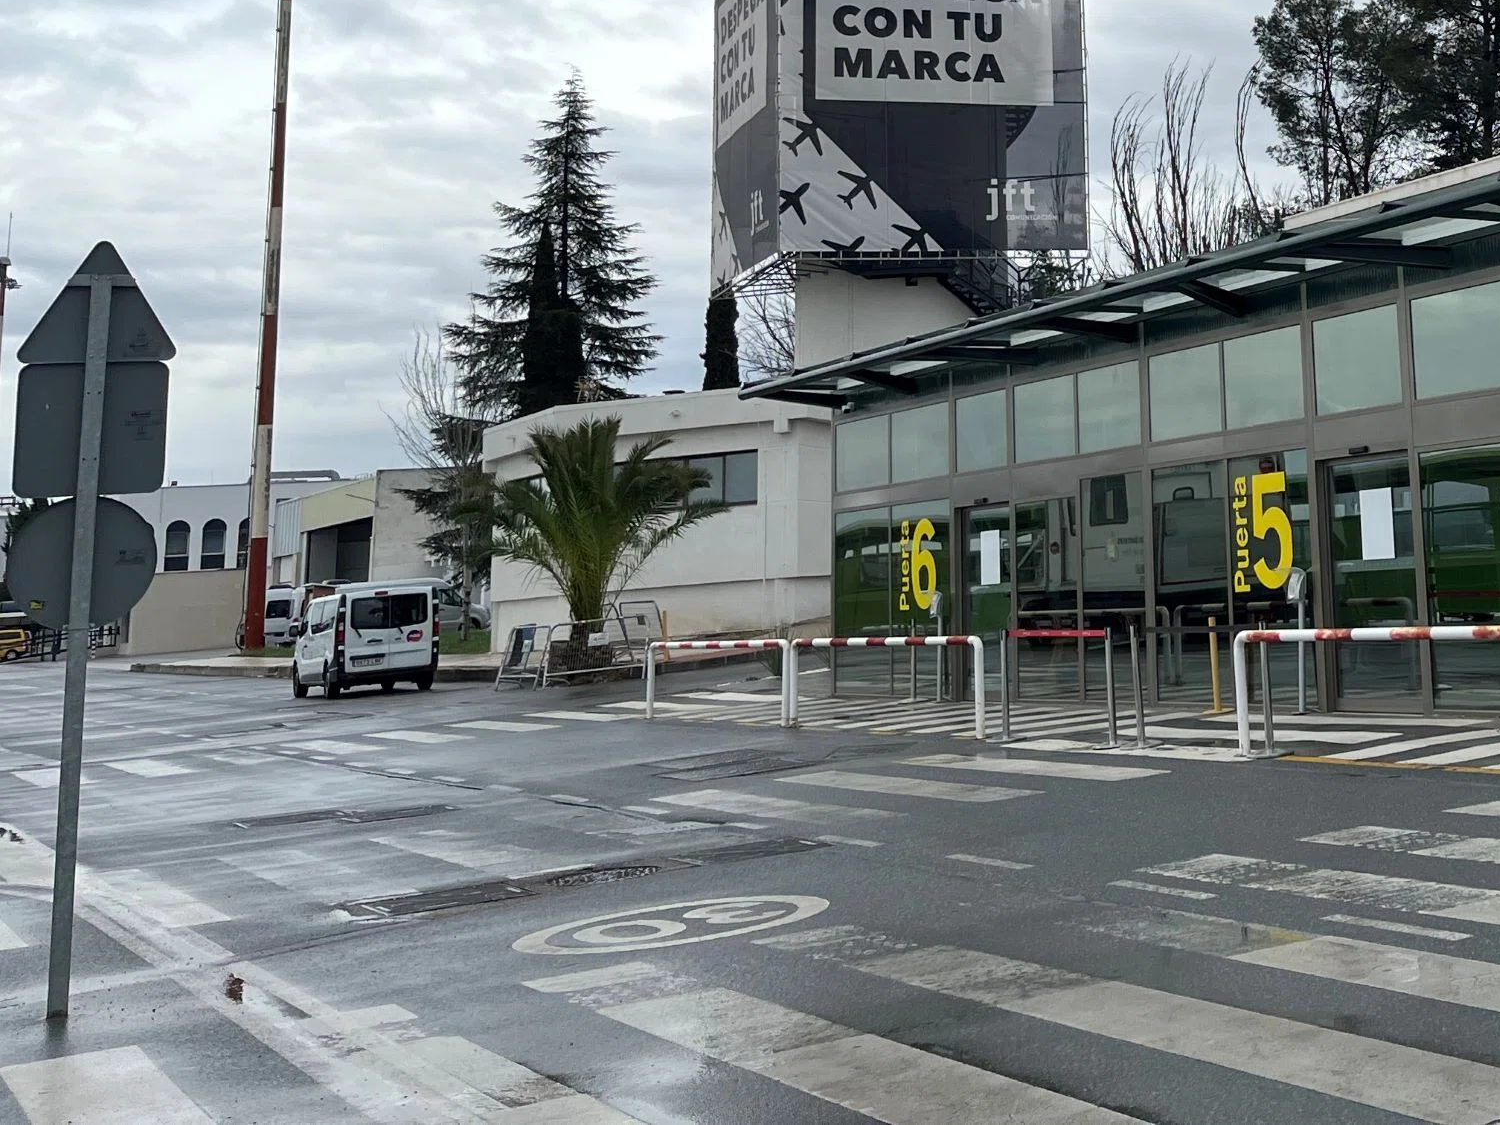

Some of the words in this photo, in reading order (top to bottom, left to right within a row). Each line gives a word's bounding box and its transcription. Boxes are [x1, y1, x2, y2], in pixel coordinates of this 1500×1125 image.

[832, 4, 933, 39] CON
[946, 10, 1003, 43] TU
[720, 39, 739, 84] CON
[741, 24, 756, 62] TU
[834, 47, 1006, 83] MARCA
[720, 67, 756, 124] MARCA
[750, 188, 764, 237] jft
[986, 178, 1036, 222] jft
[1233, 475, 1251, 593] Puerta
[1252, 471, 1294, 590] 5
[900, 519, 910, 611] Puerta
[911, 518, 937, 610] 6
